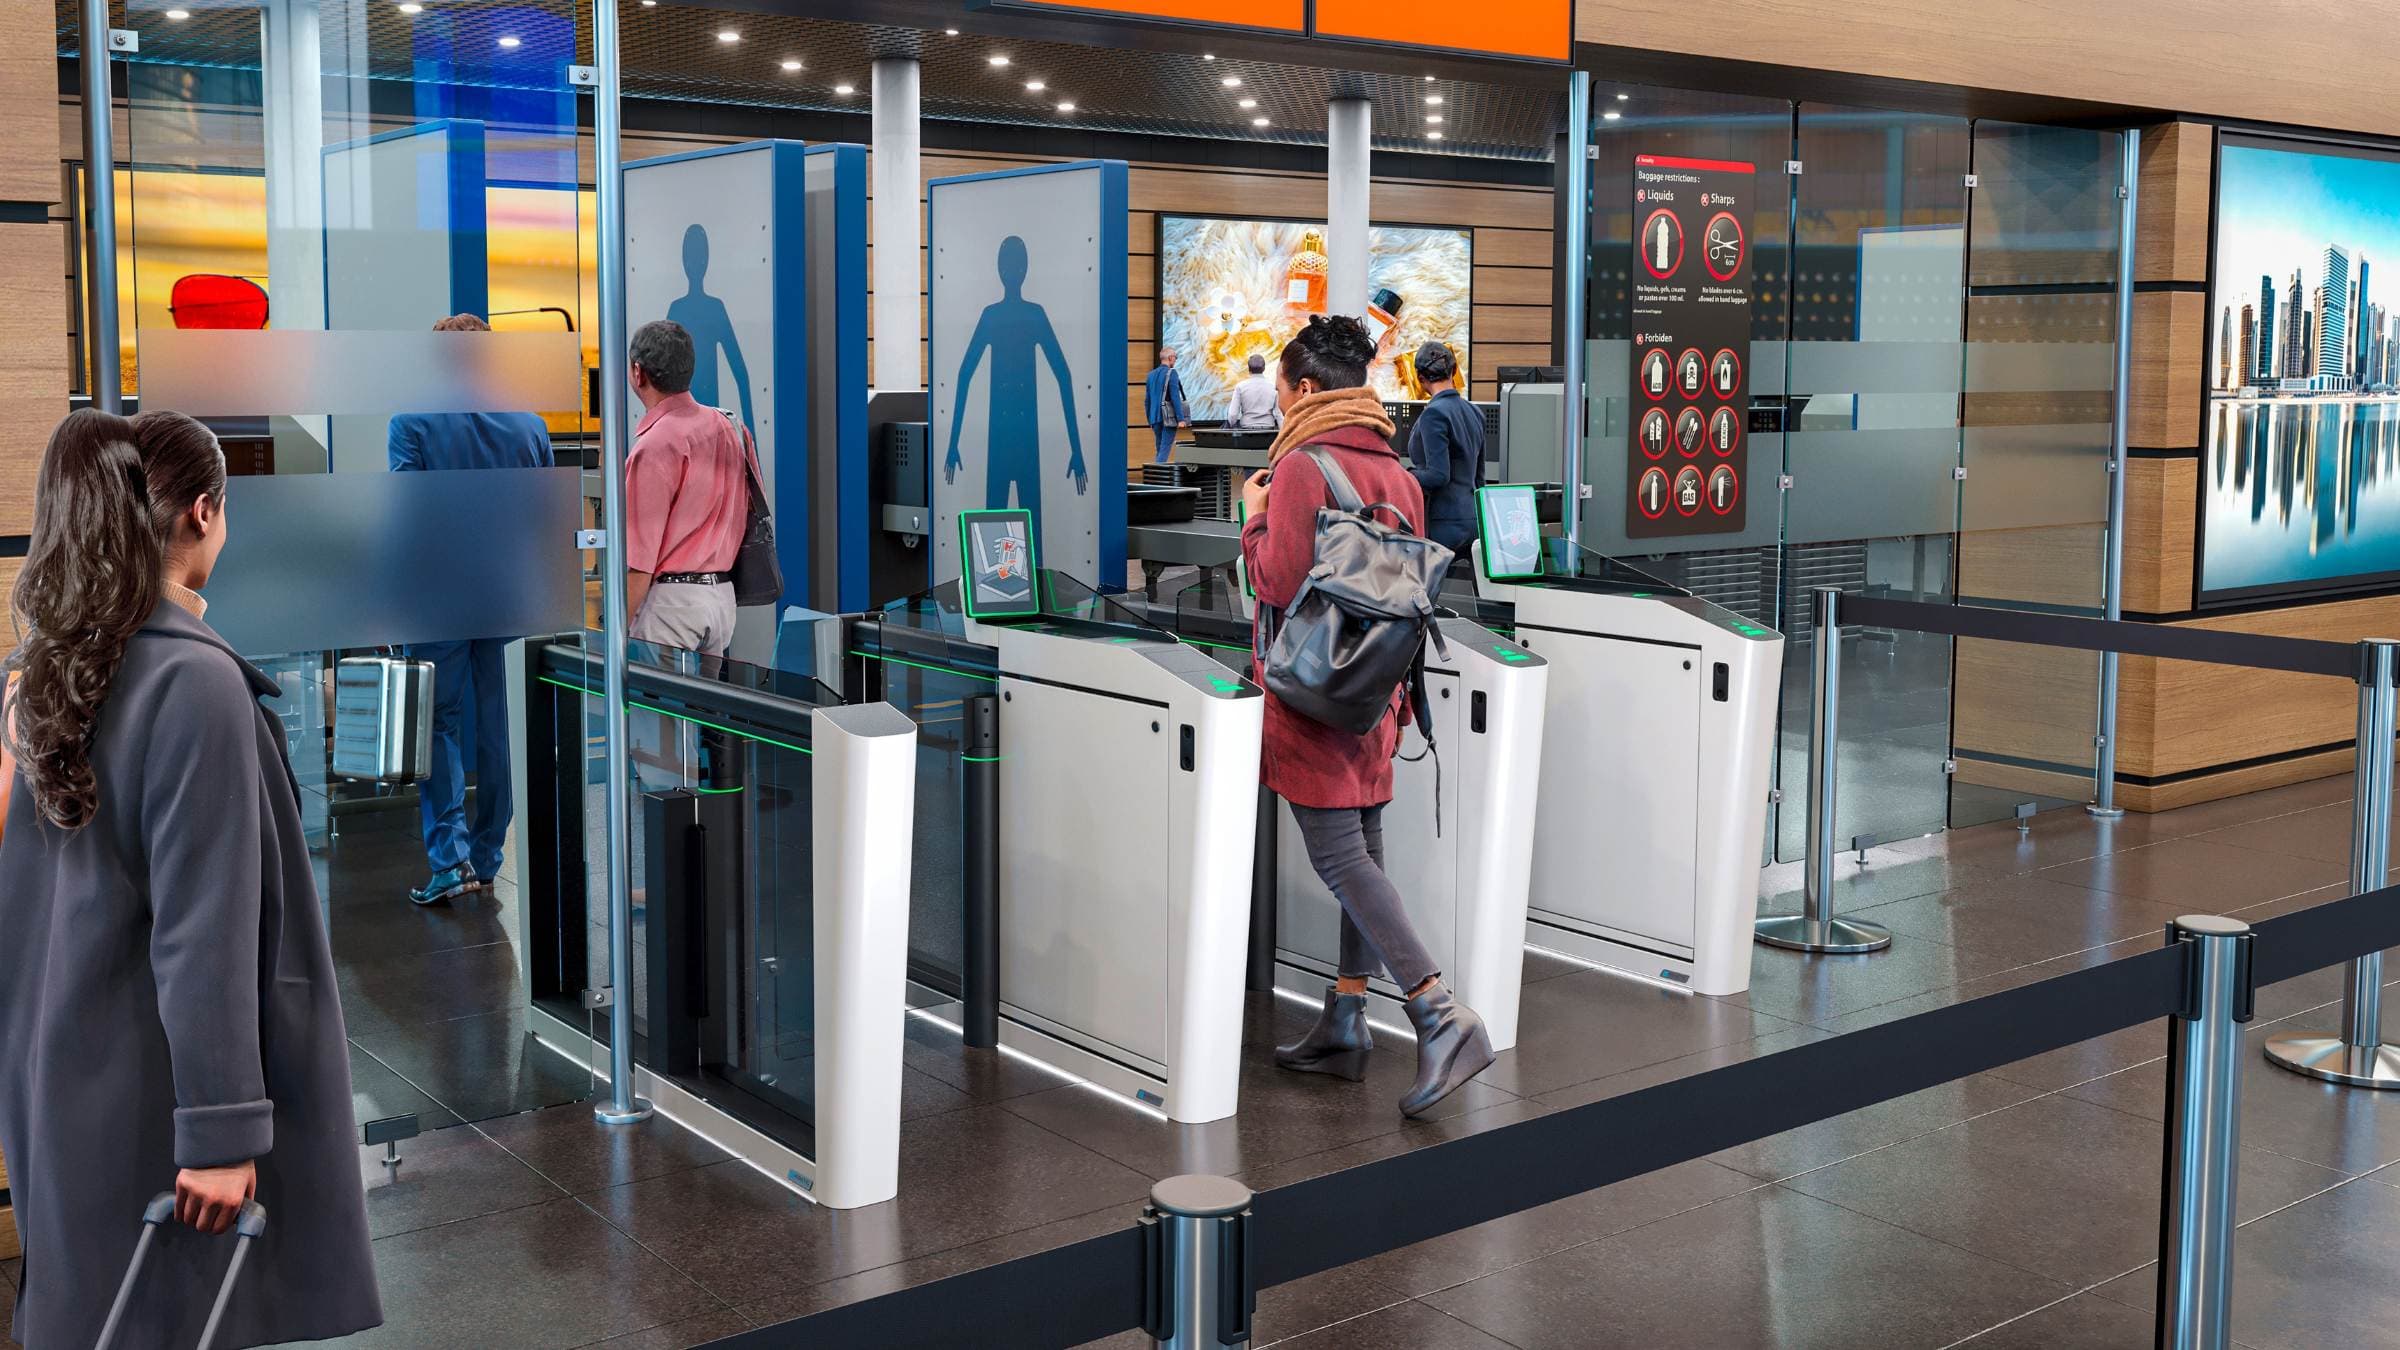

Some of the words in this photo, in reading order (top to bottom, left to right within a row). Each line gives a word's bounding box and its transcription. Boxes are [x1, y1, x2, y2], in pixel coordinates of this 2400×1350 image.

[1638, 171, 1664, 182] Baggage
[1647, 189, 1674, 202] Liquids
[1711, 193, 1735, 206] Sharps
[1725, 258, 1735, 266] 6cm
[1709, 286, 1722, 294] blades
[1643, 295, 1658, 303] pastes
[1698, 295, 1714, 303] allowed
[1731, 296, 1748, 305] luggage
[1645, 333, 1673, 343] Forbiden
[1683, 492, 1695, 502] GAS
